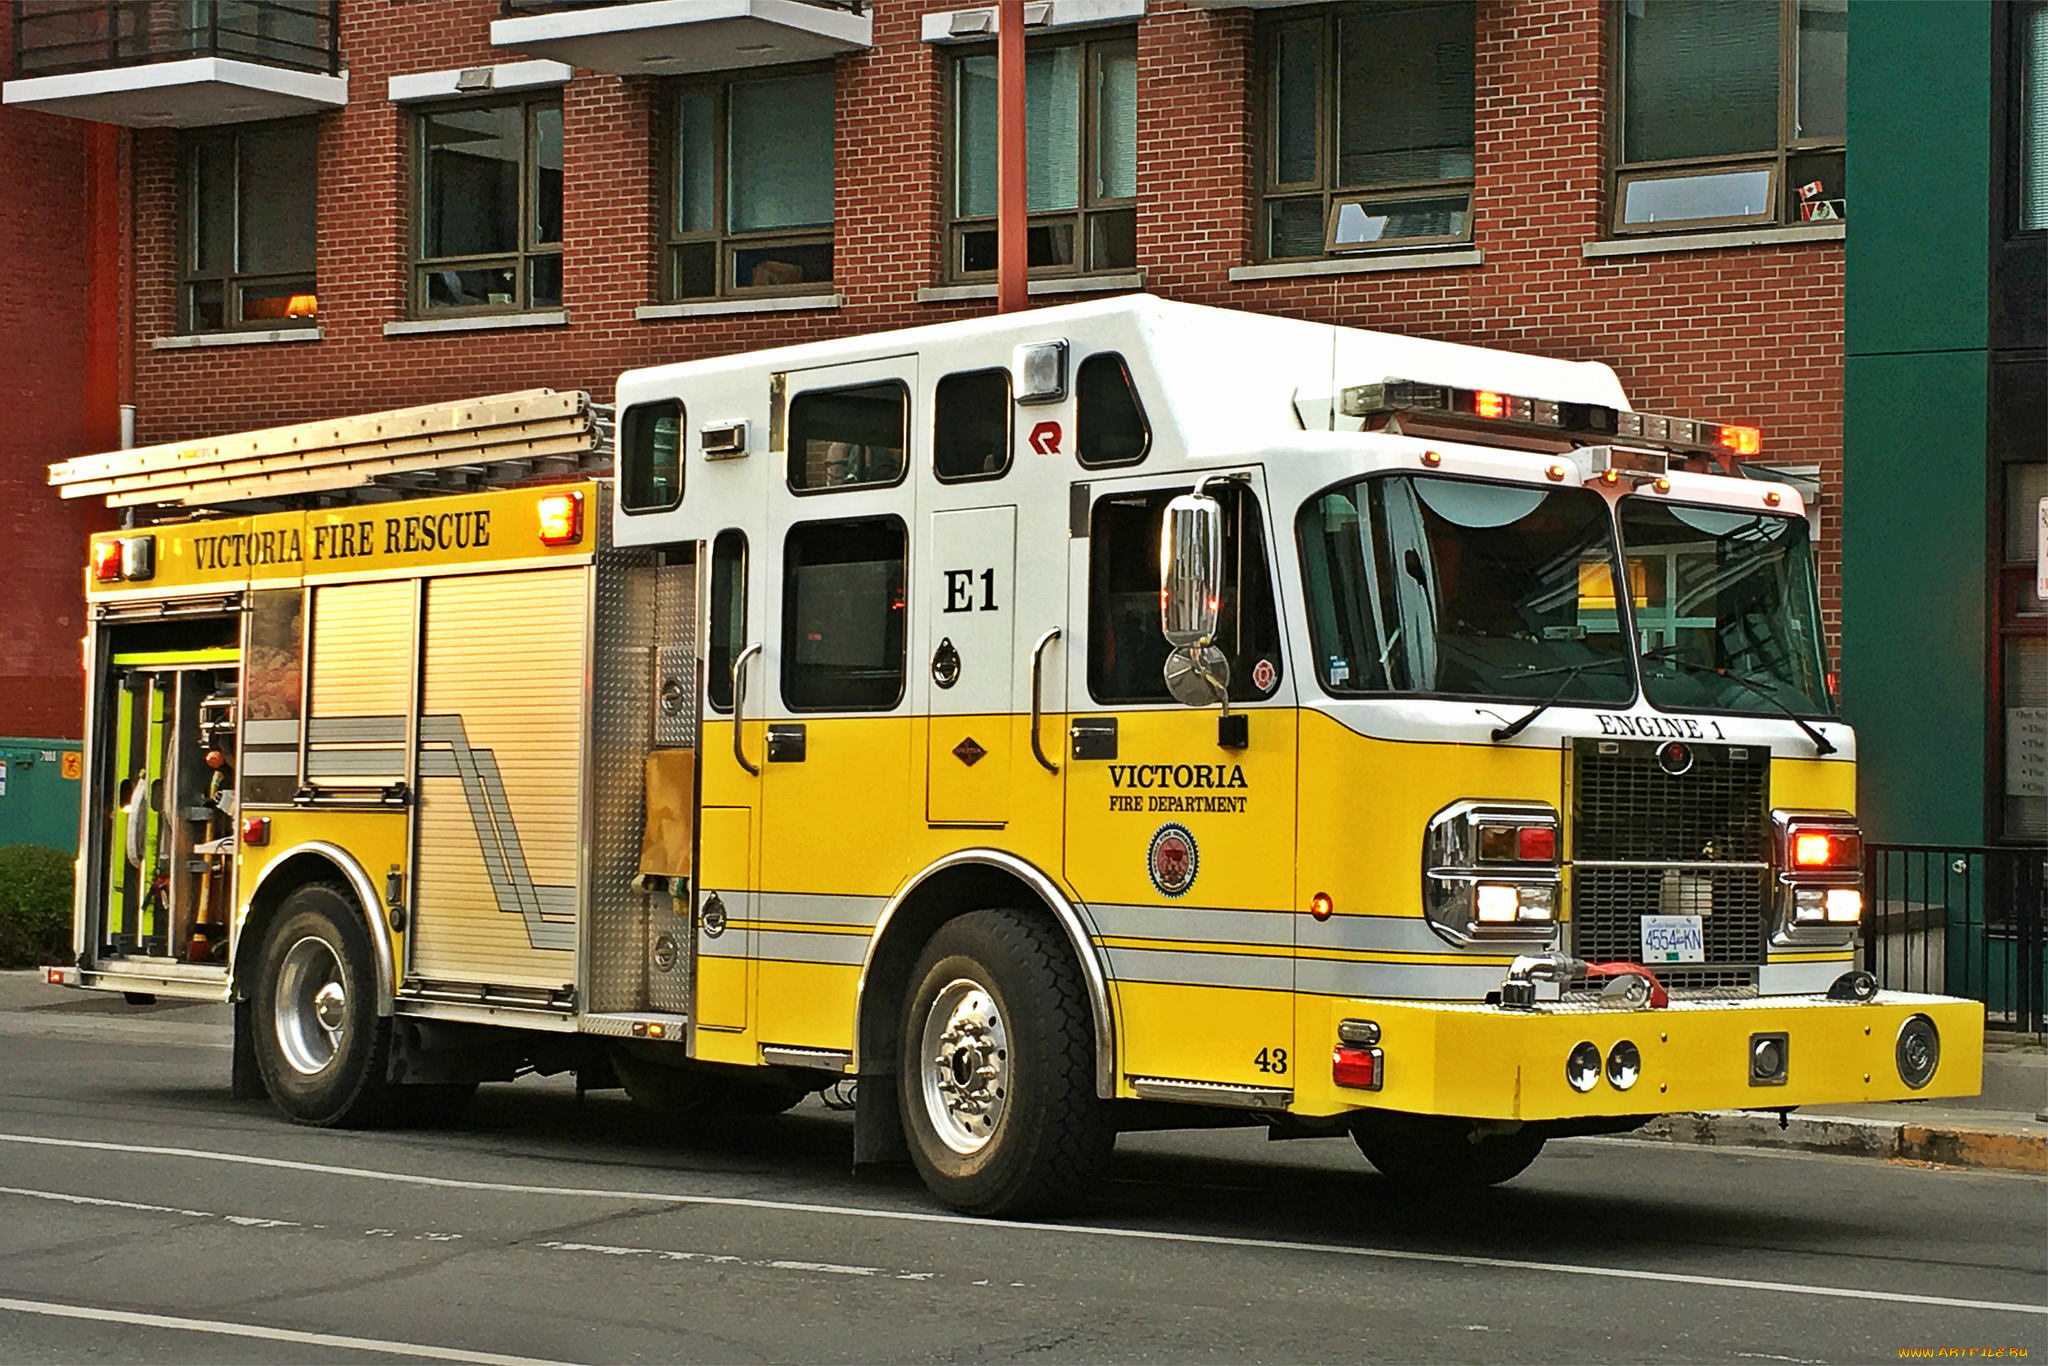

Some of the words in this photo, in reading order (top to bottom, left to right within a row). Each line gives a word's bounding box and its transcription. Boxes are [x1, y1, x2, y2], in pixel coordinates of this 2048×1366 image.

[194, 529, 303, 569] VICTORIA
[313, 521, 374, 560] FIRE
[384, 510, 490, 553] RESCUE
[943, 568, 998, 613] E1
[1594, 714, 1703, 739] ENGINE
[1710, 721, 1726, 740] 1
[1108, 765, 1248, 788] VICTORIA
[1109, 795, 1143, 812] FIRE
[1148, 796, 1247, 813] DEPARTMENT
[1254, 1047, 1287, 1074] 43
